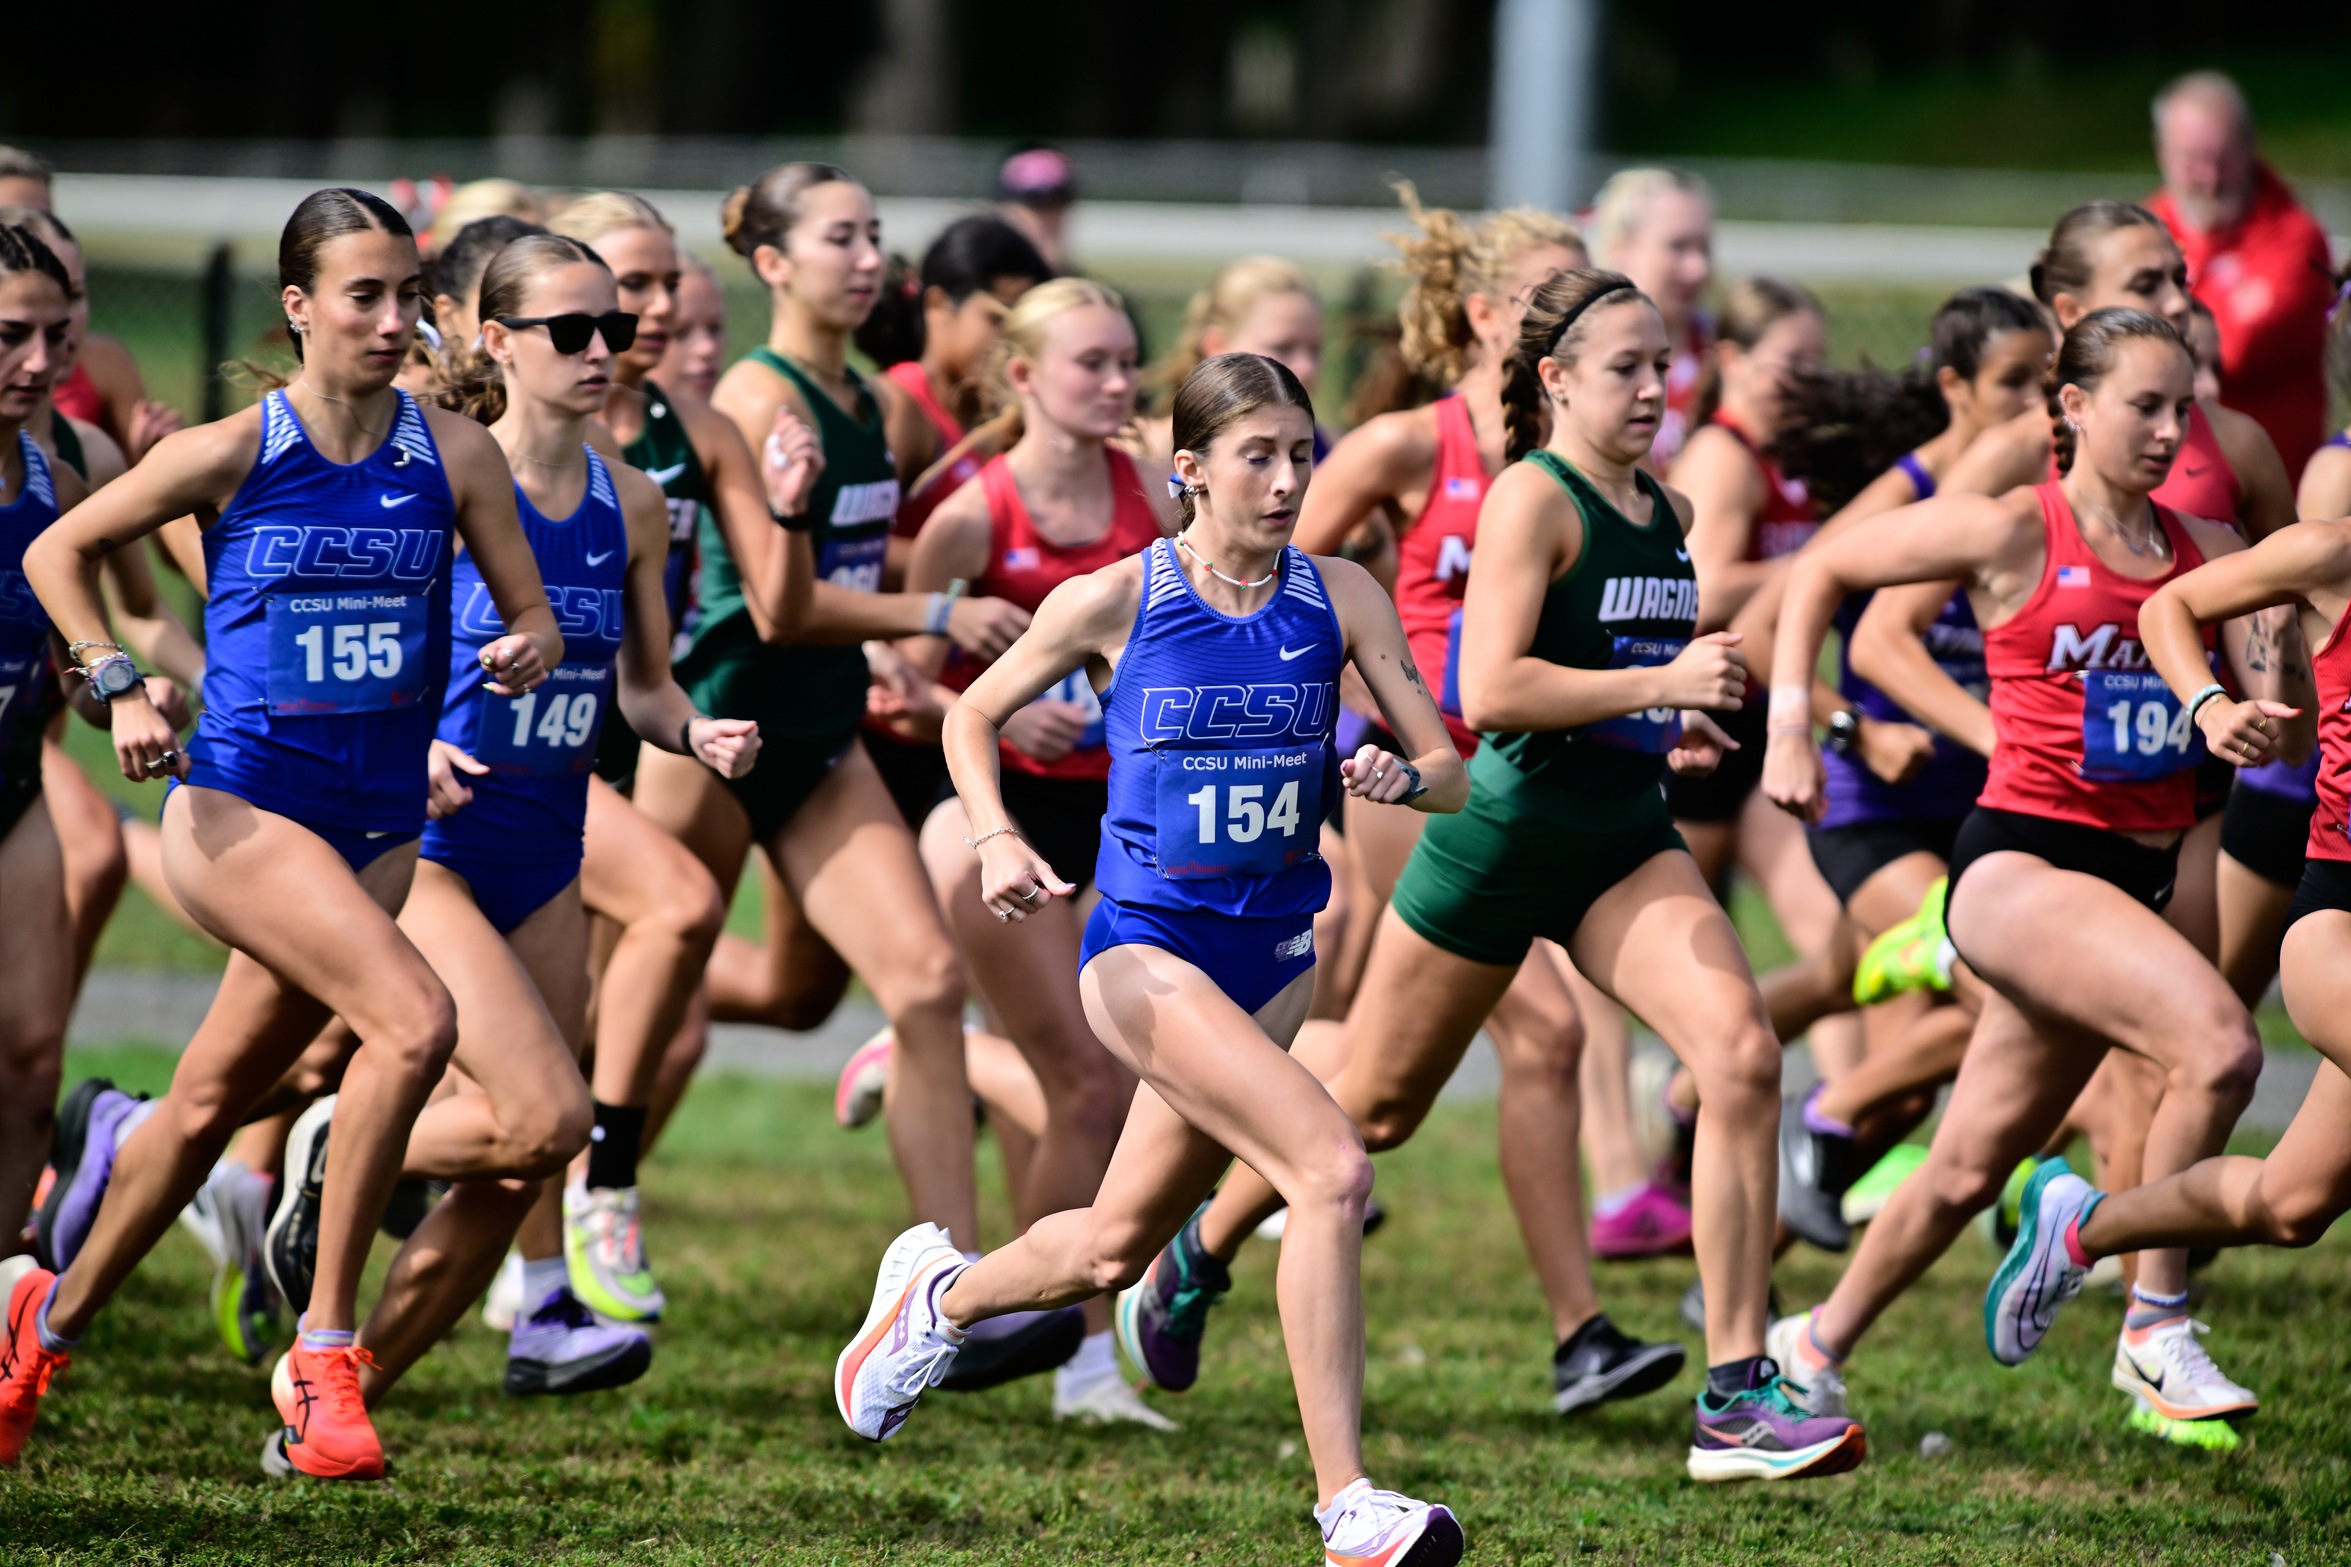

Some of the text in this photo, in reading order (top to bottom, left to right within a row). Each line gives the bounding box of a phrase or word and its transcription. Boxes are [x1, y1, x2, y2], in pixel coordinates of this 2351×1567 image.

[245, 525, 444, 580] CCSU
[290, 594, 408, 613] CCSU Mini-Meet
[295, 621, 403, 683] 155
[2104, 674, 2140, 691] CCSU
[509, 692, 598, 748] 149
[1140, 681, 1334, 743] CCSU
[2107, 699, 2193, 756] 194
[1182, 752, 1308, 771] CCSU Mini-Meet
[1187, 780, 1301, 844] 154
